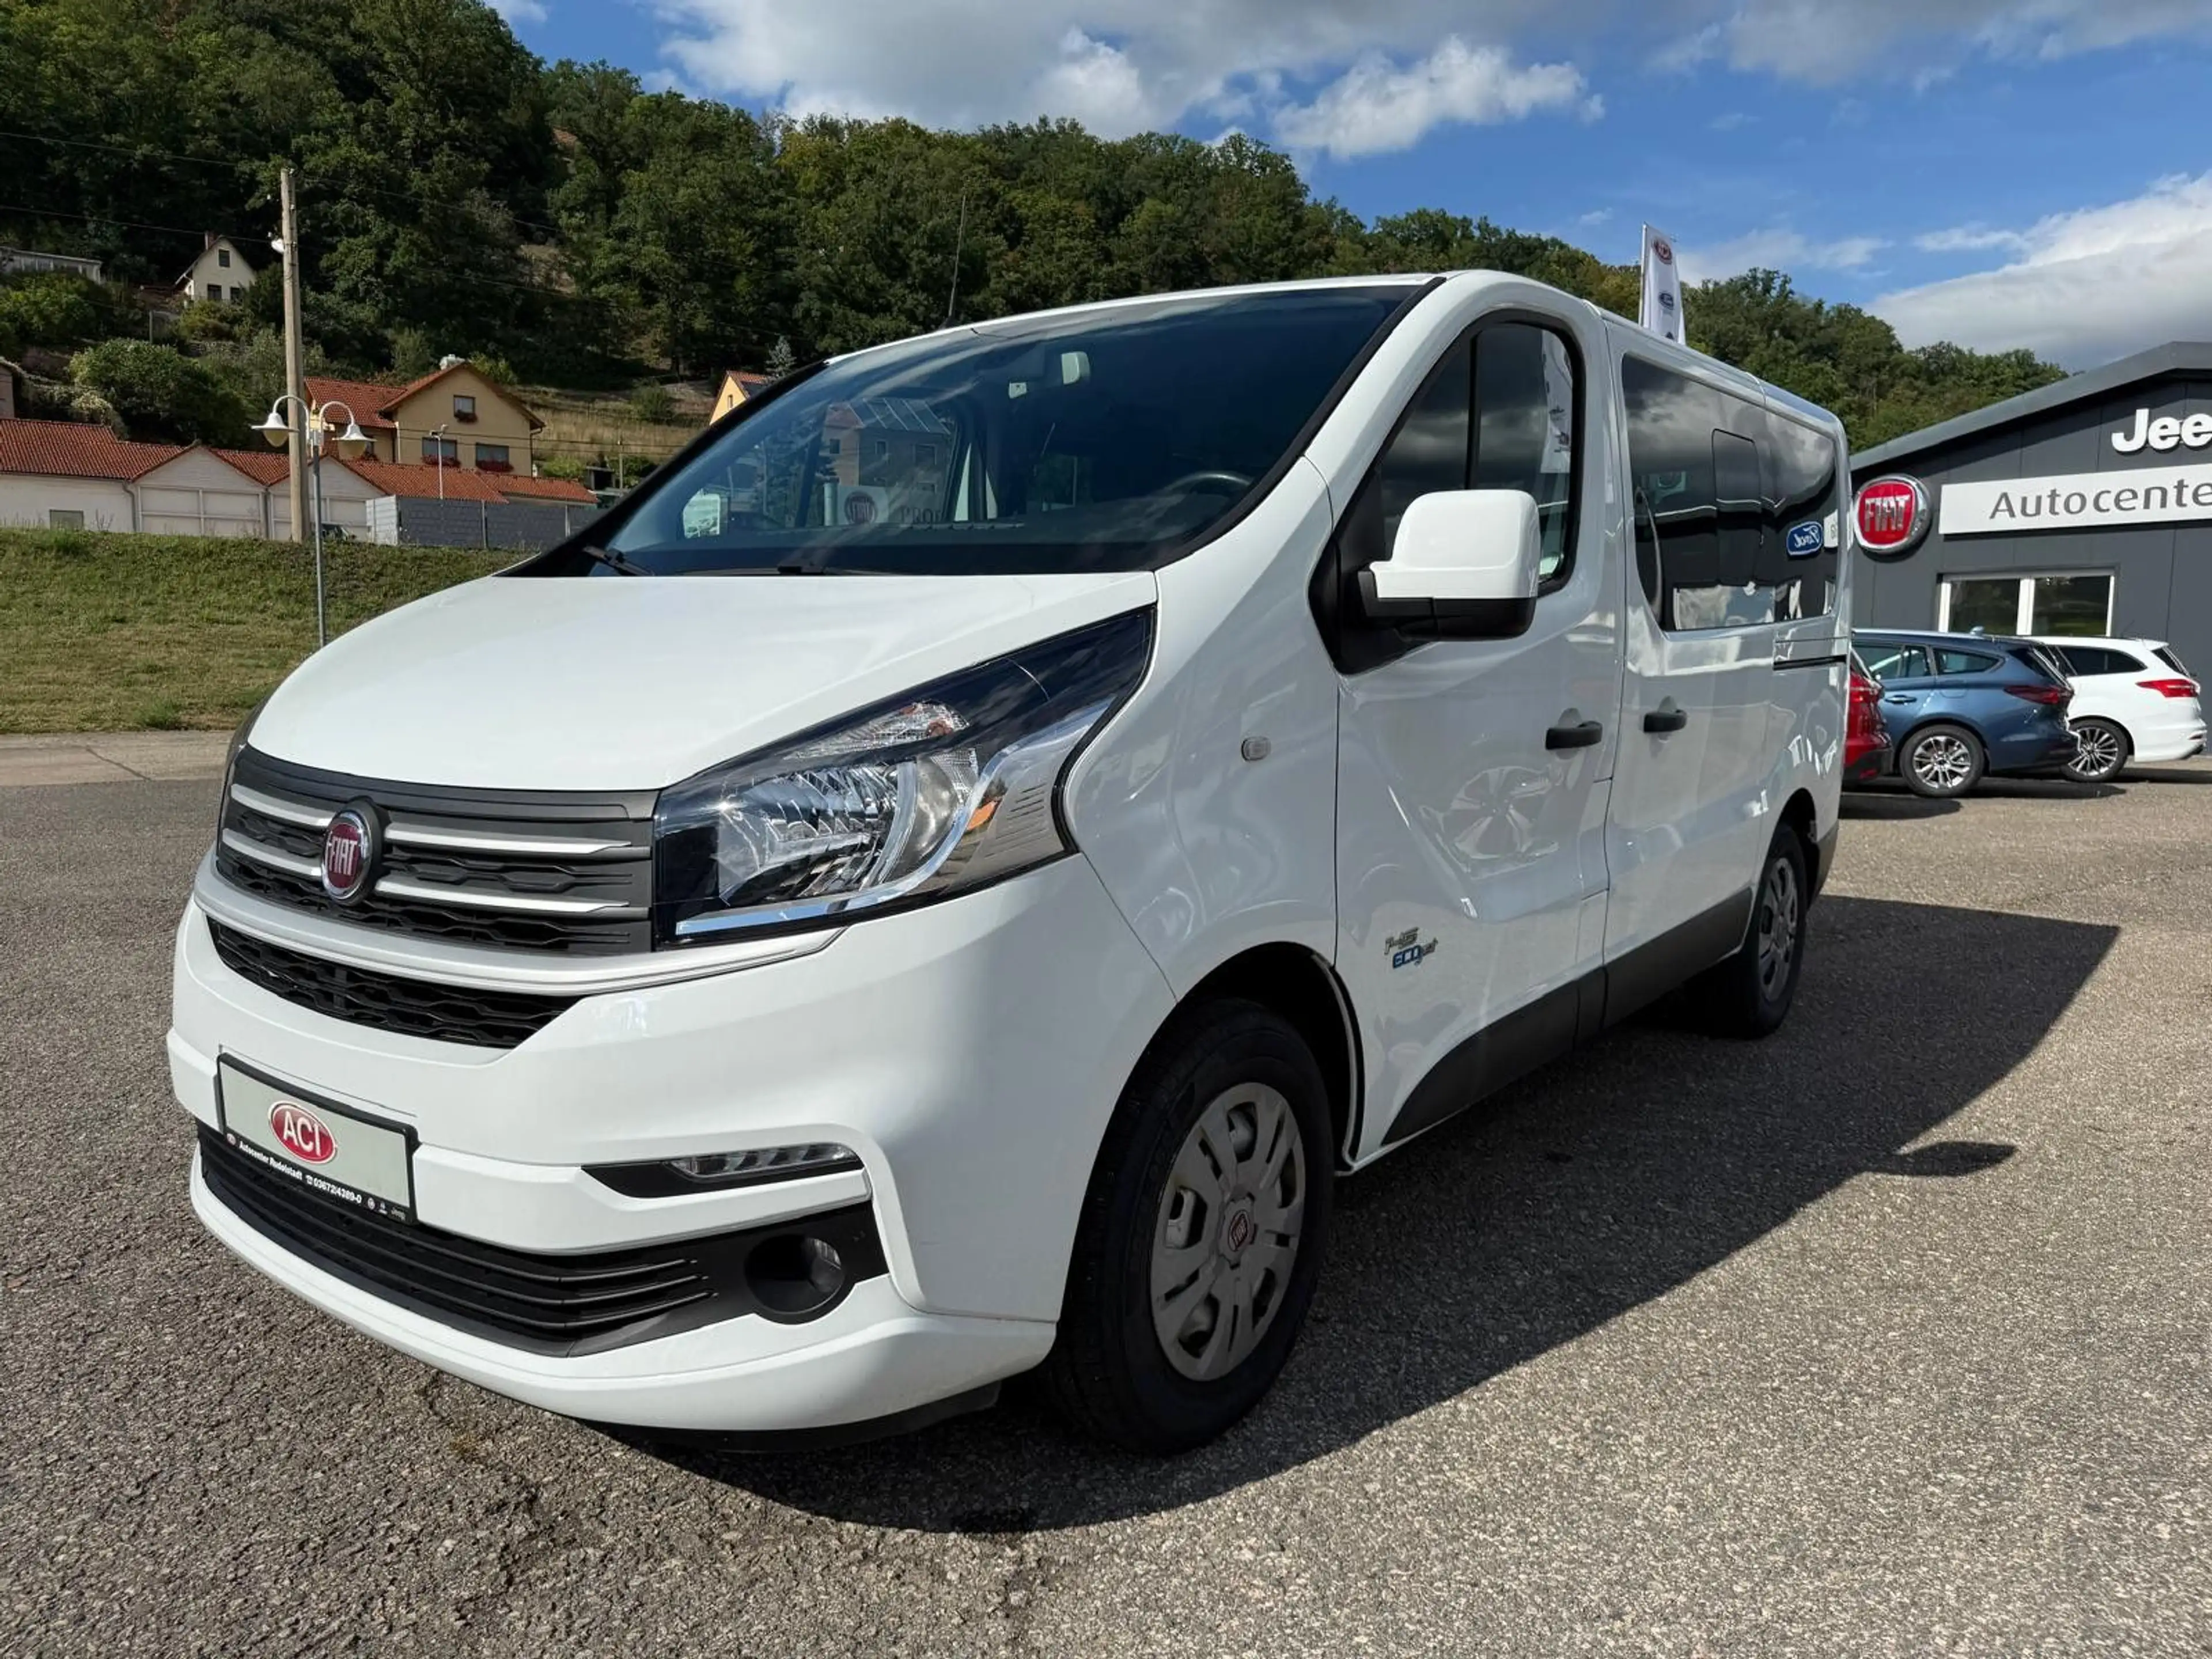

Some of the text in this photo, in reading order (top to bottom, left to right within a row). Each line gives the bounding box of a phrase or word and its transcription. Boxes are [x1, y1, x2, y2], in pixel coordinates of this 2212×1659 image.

[2111, 408, 2212, 452] Jee
[1864, 494, 1911, 532] FIAT
[1988, 478, 2212, 520] Autocente
[329, 836, 358, 876] FIAT
[283, 1111, 321, 1157] ACI
